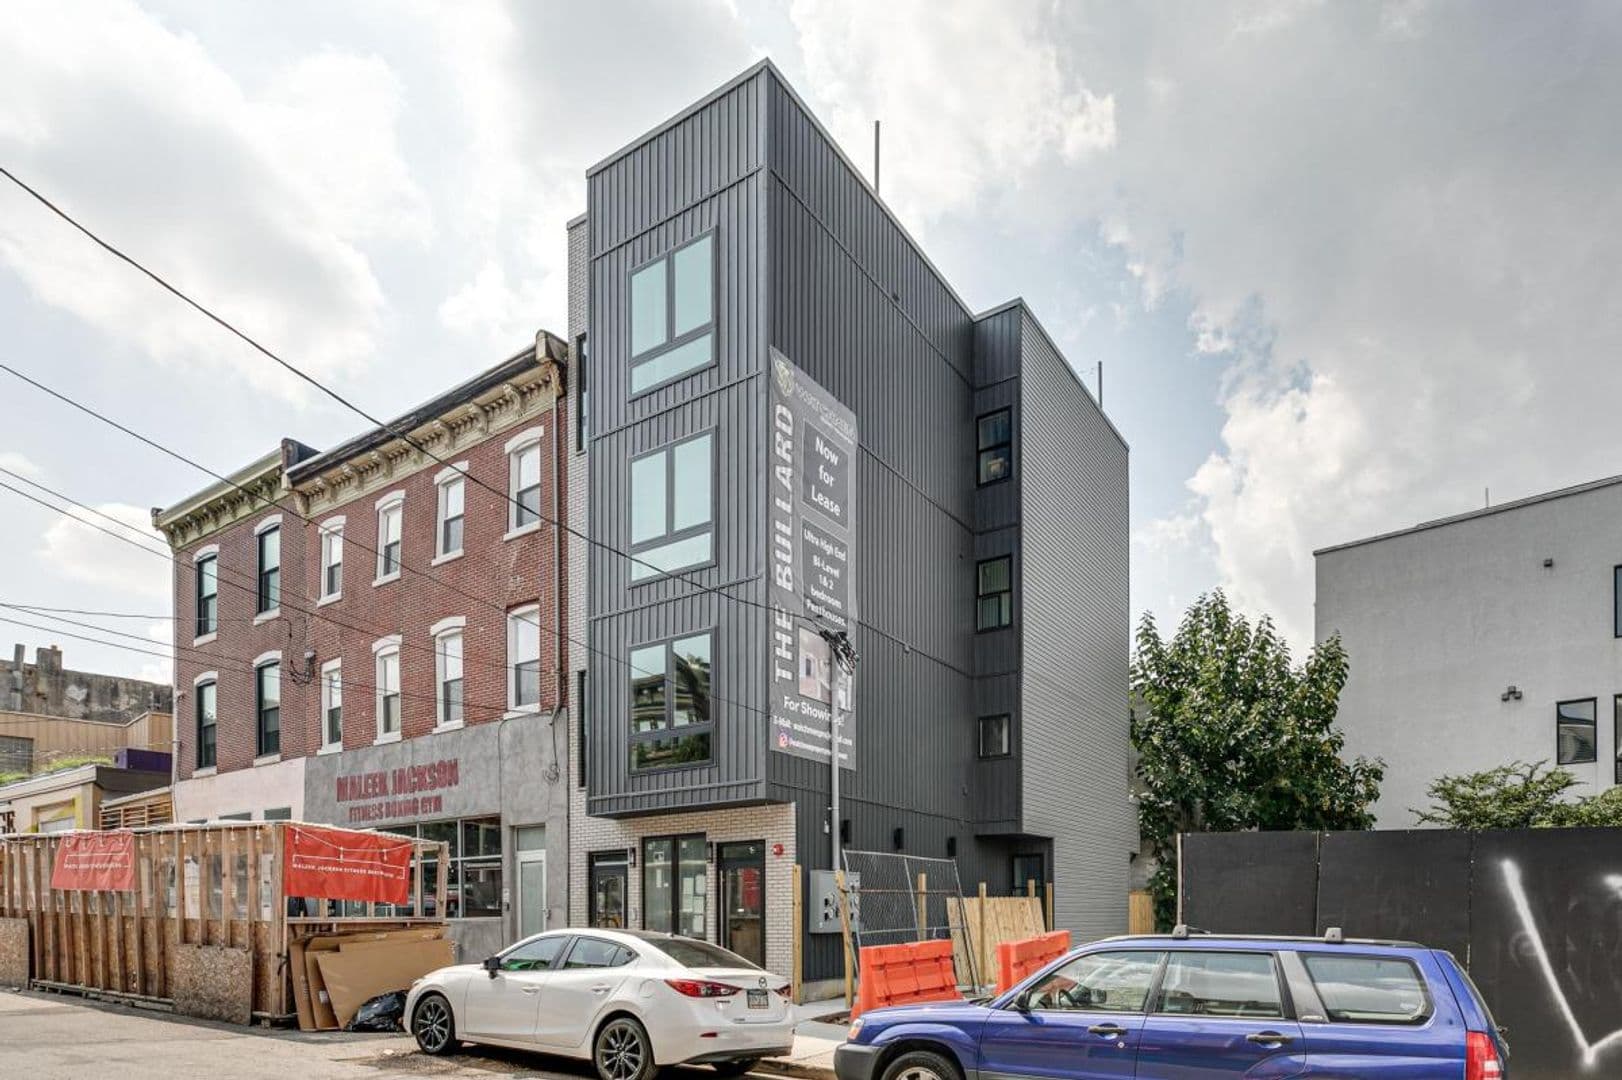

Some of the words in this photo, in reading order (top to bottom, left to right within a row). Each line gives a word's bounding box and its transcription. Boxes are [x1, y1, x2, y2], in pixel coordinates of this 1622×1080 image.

[815, 436, 840, 467] Now
[818, 463, 835, 488] for
[775, 404, 794, 593] BULLARD
[811, 485, 841, 517] Lease
[834, 547, 847, 562] End
[829, 579, 835, 590] 2
[775, 604, 794, 684] THE
[784, 695, 800, 713] For
[336, 771, 388, 802] MALEEK
[392, 758, 459, 796] JACKSON
[349, 803, 384, 822] FITNESS
[385, 798, 419, 819] BOXING
[421, 795, 443, 814] GYM
